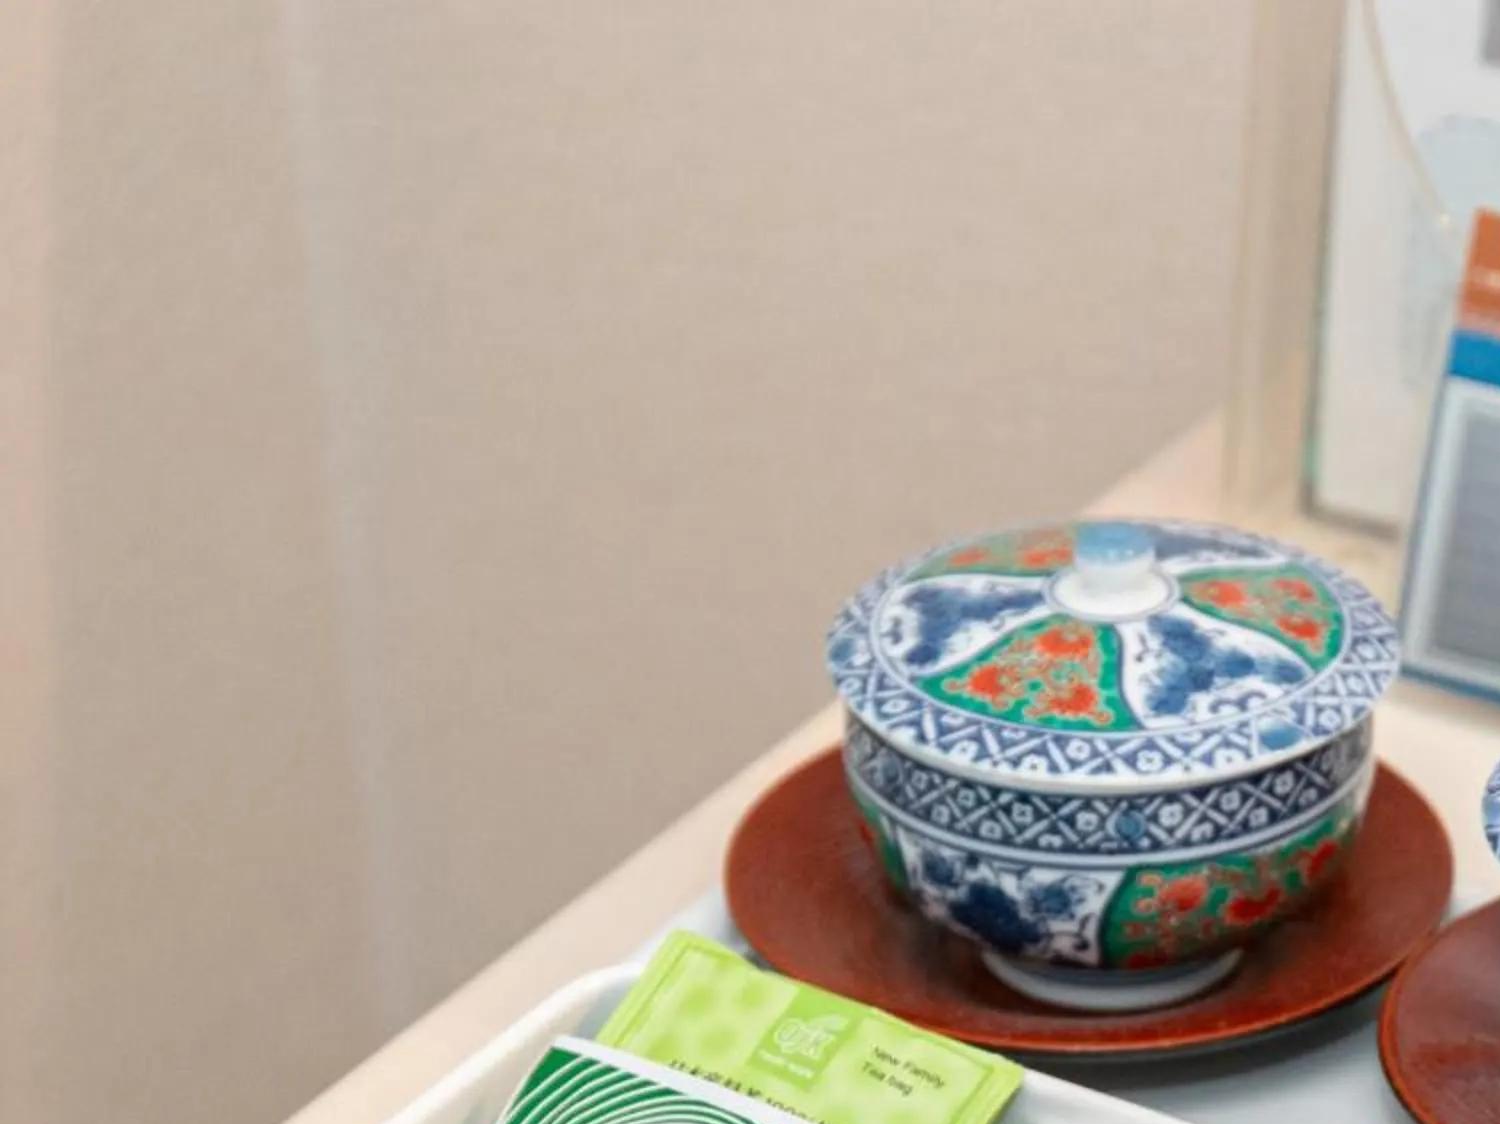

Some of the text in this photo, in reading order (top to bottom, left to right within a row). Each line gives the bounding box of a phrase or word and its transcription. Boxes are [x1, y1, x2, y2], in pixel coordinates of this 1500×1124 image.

[862, 1060, 886, 1082] Tea
[873, 1045, 945, 1090] New Family
